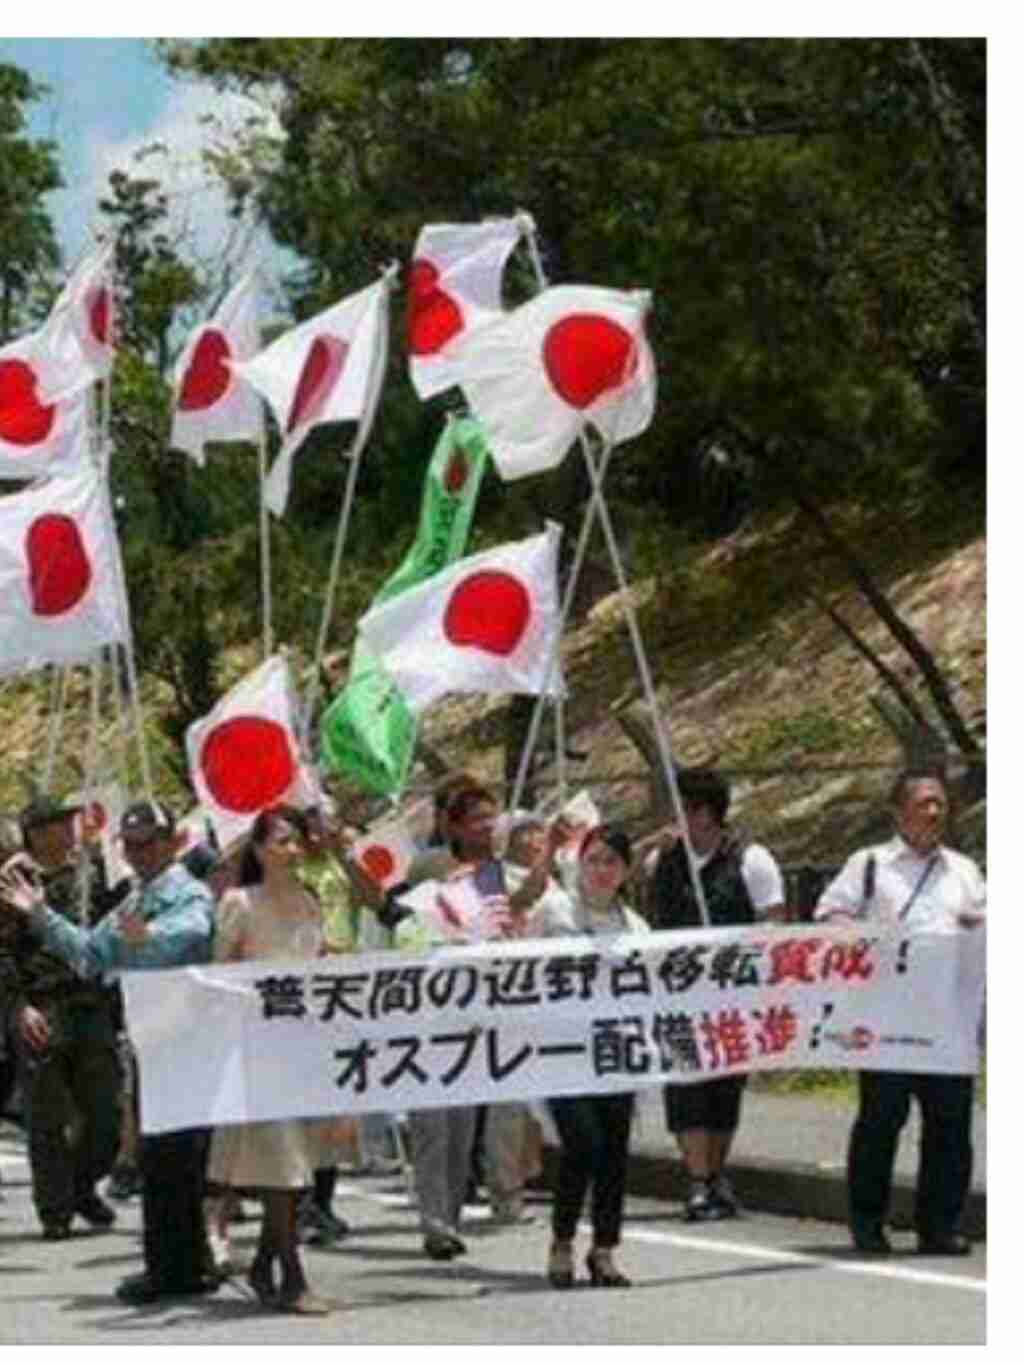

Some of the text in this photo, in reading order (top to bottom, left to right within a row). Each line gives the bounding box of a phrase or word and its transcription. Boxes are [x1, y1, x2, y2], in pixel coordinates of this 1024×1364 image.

[333, 1003, 834, 1093] オスプレー配備推進！
